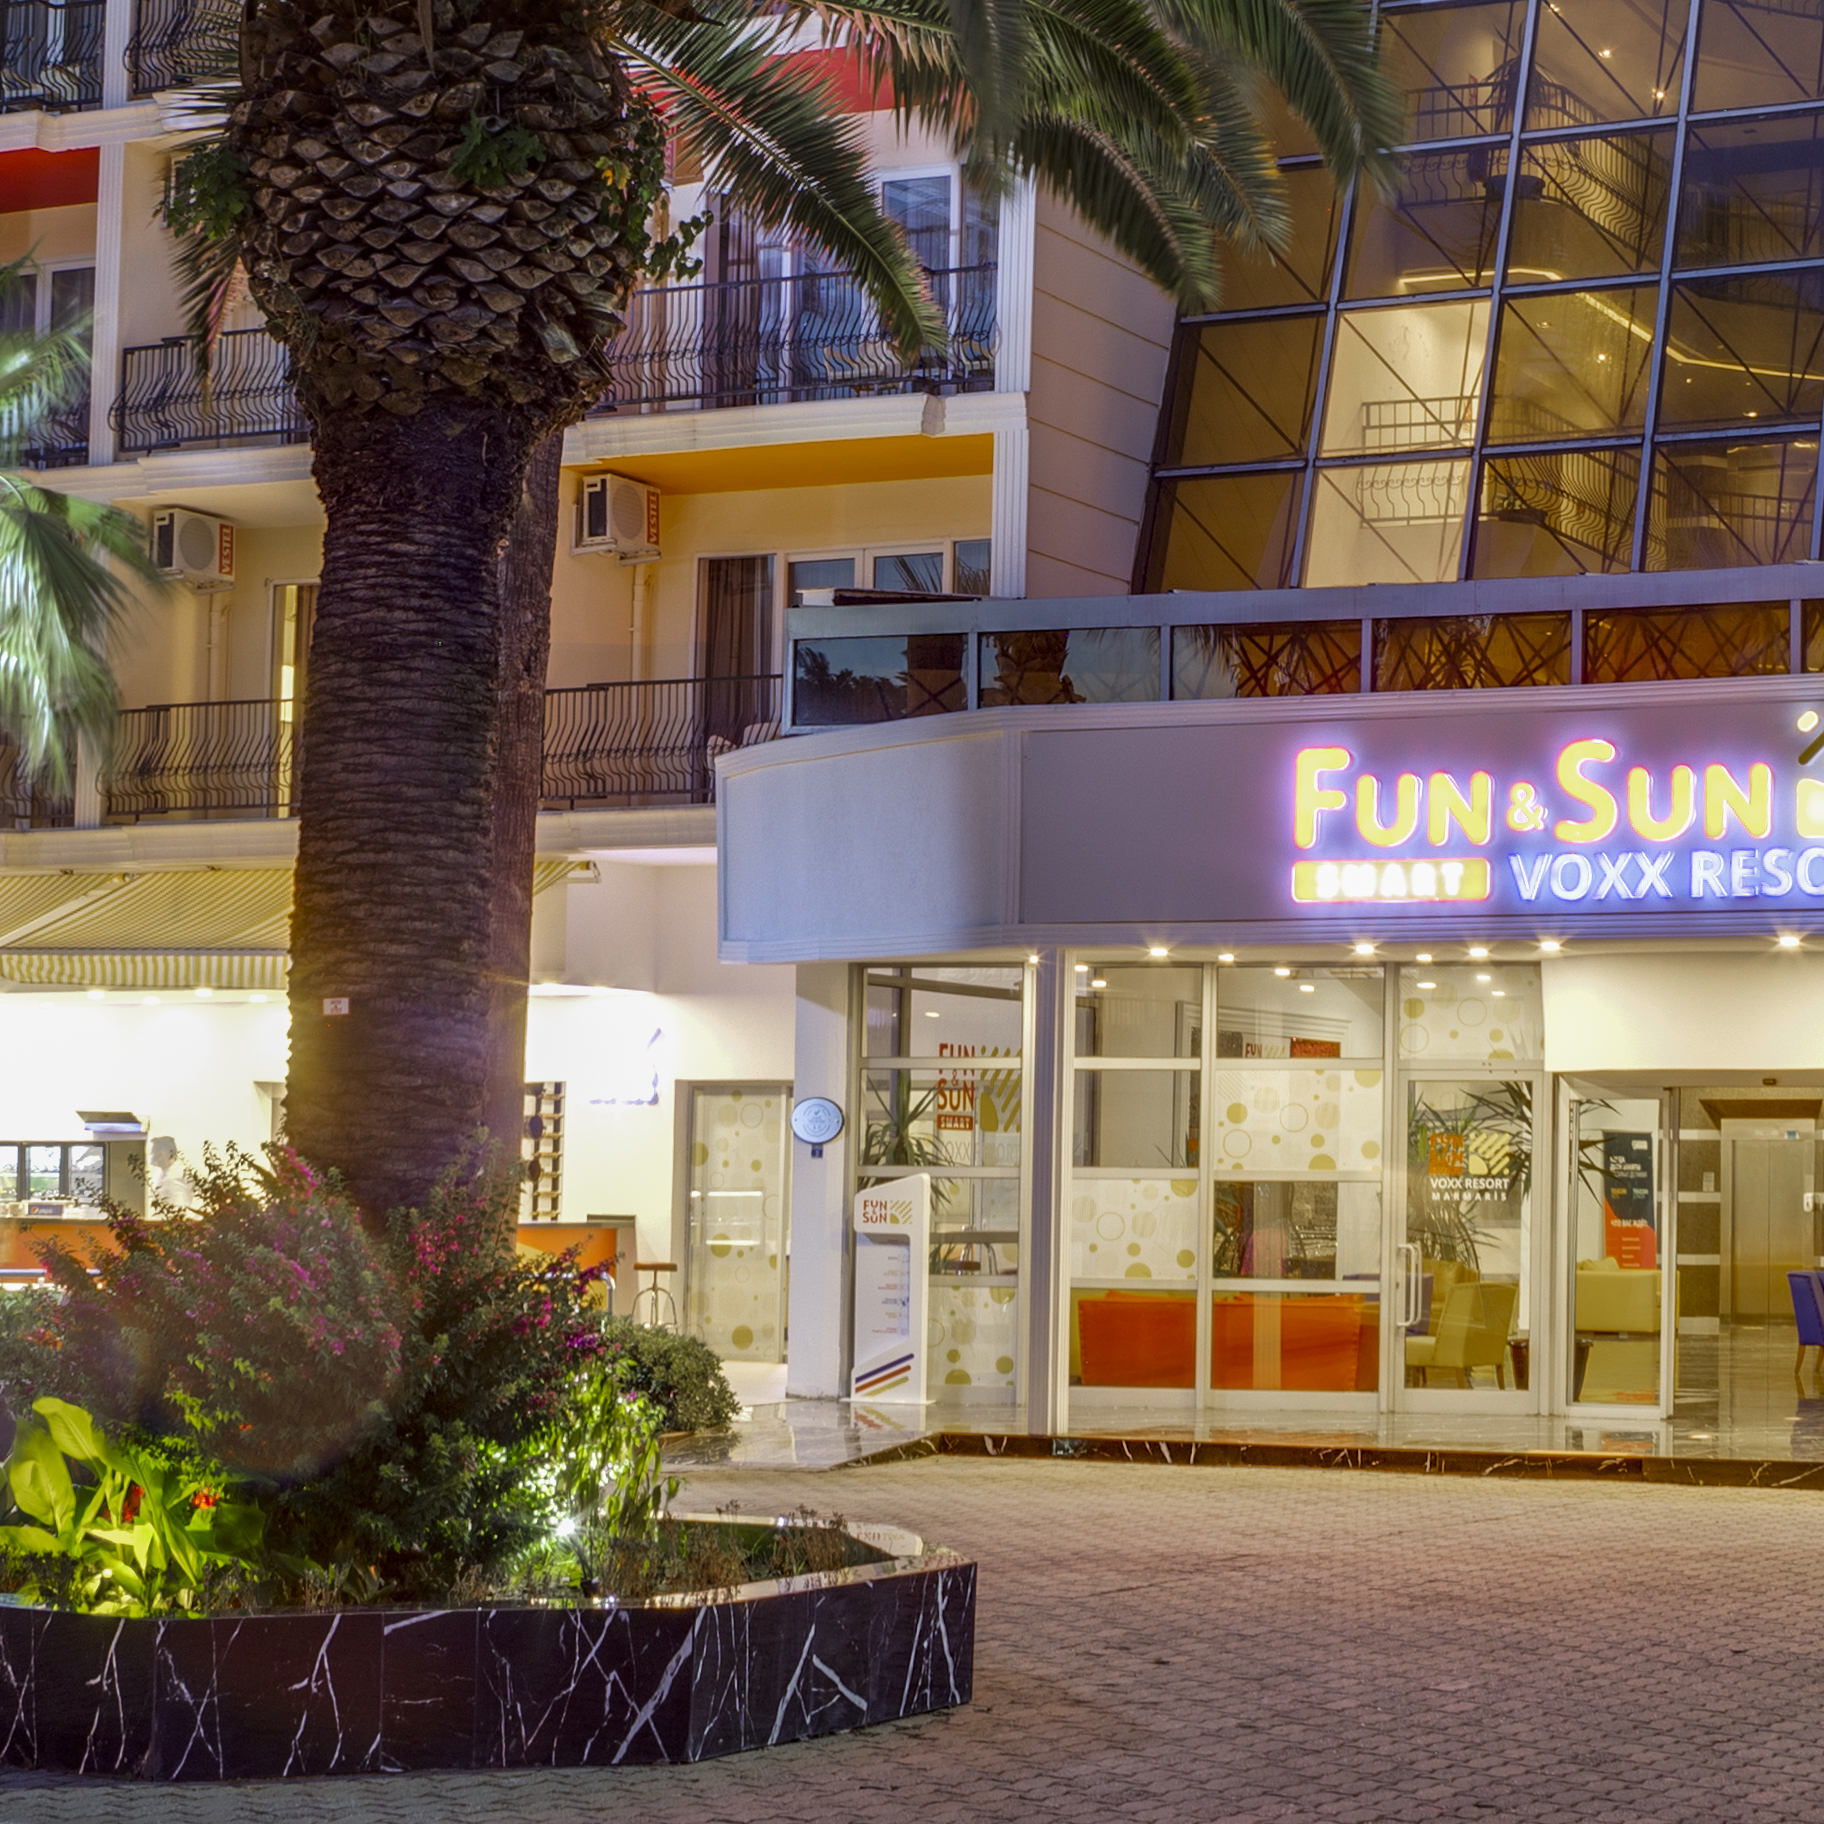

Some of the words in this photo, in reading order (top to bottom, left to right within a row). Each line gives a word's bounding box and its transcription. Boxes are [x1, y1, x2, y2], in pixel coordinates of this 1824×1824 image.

[649, 493, 658, 543] VESTEL
[221, 526, 232, 573] VESTEL
[1506, 781, 1546, 832] &
[1316, 863, 1465, 898] SMART
[1509, 850, 1675, 901] VOXX
[937, 1078, 975, 1111] SUN
[941, 1116, 971, 1128] SMART
[1430, 1177, 1463, 1189] VOXX
[1464, 1177, 1510, 1189] RESORT
[862, 1213, 888, 1224] SUN
[863, 1199, 888, 1212] FUN
